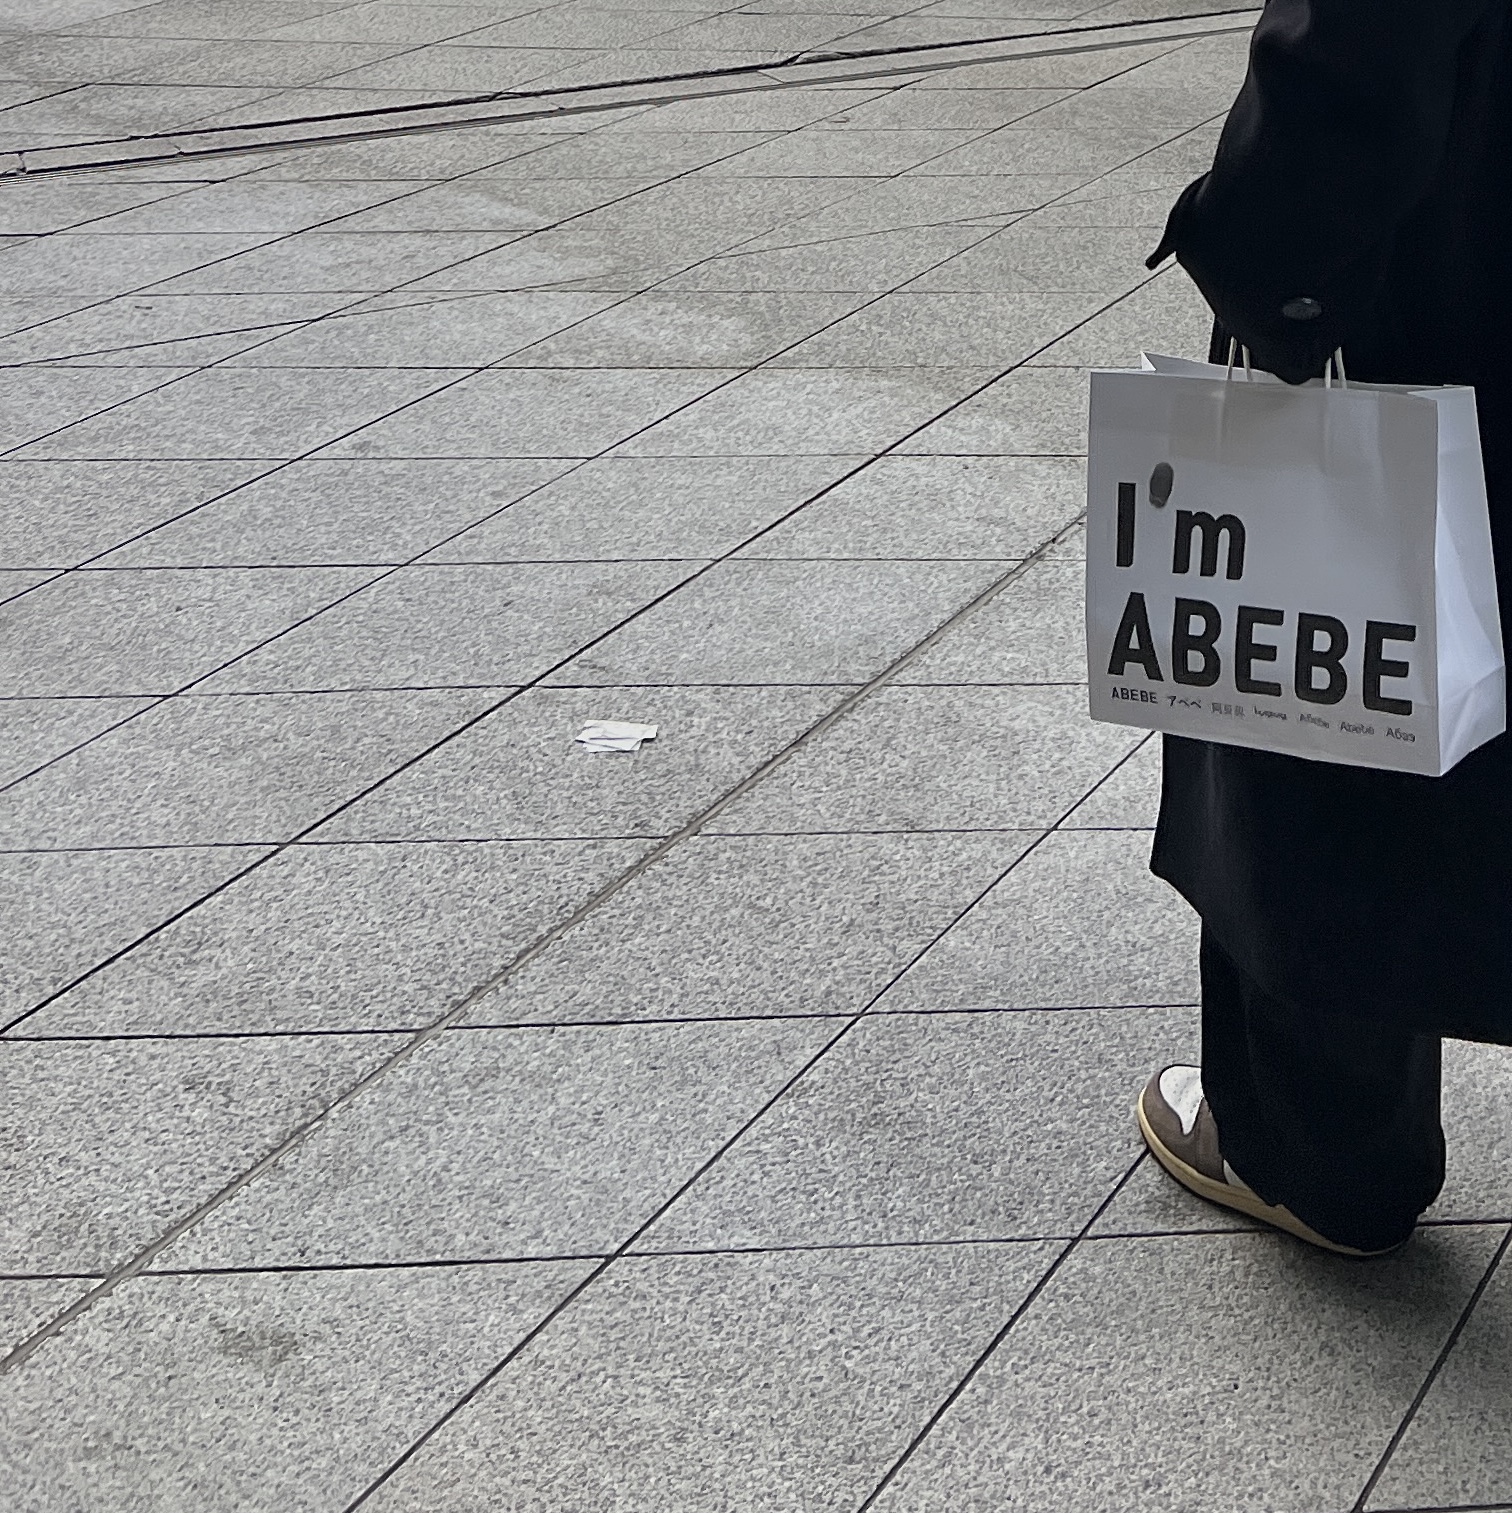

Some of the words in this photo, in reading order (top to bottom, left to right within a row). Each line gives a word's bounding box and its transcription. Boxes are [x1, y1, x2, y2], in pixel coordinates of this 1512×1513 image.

[1116, 462, 1247, 580] I'm
[1107, 591, 1418, 716] ABEBE
[1111, 686, 1159, 704] ABEBE
